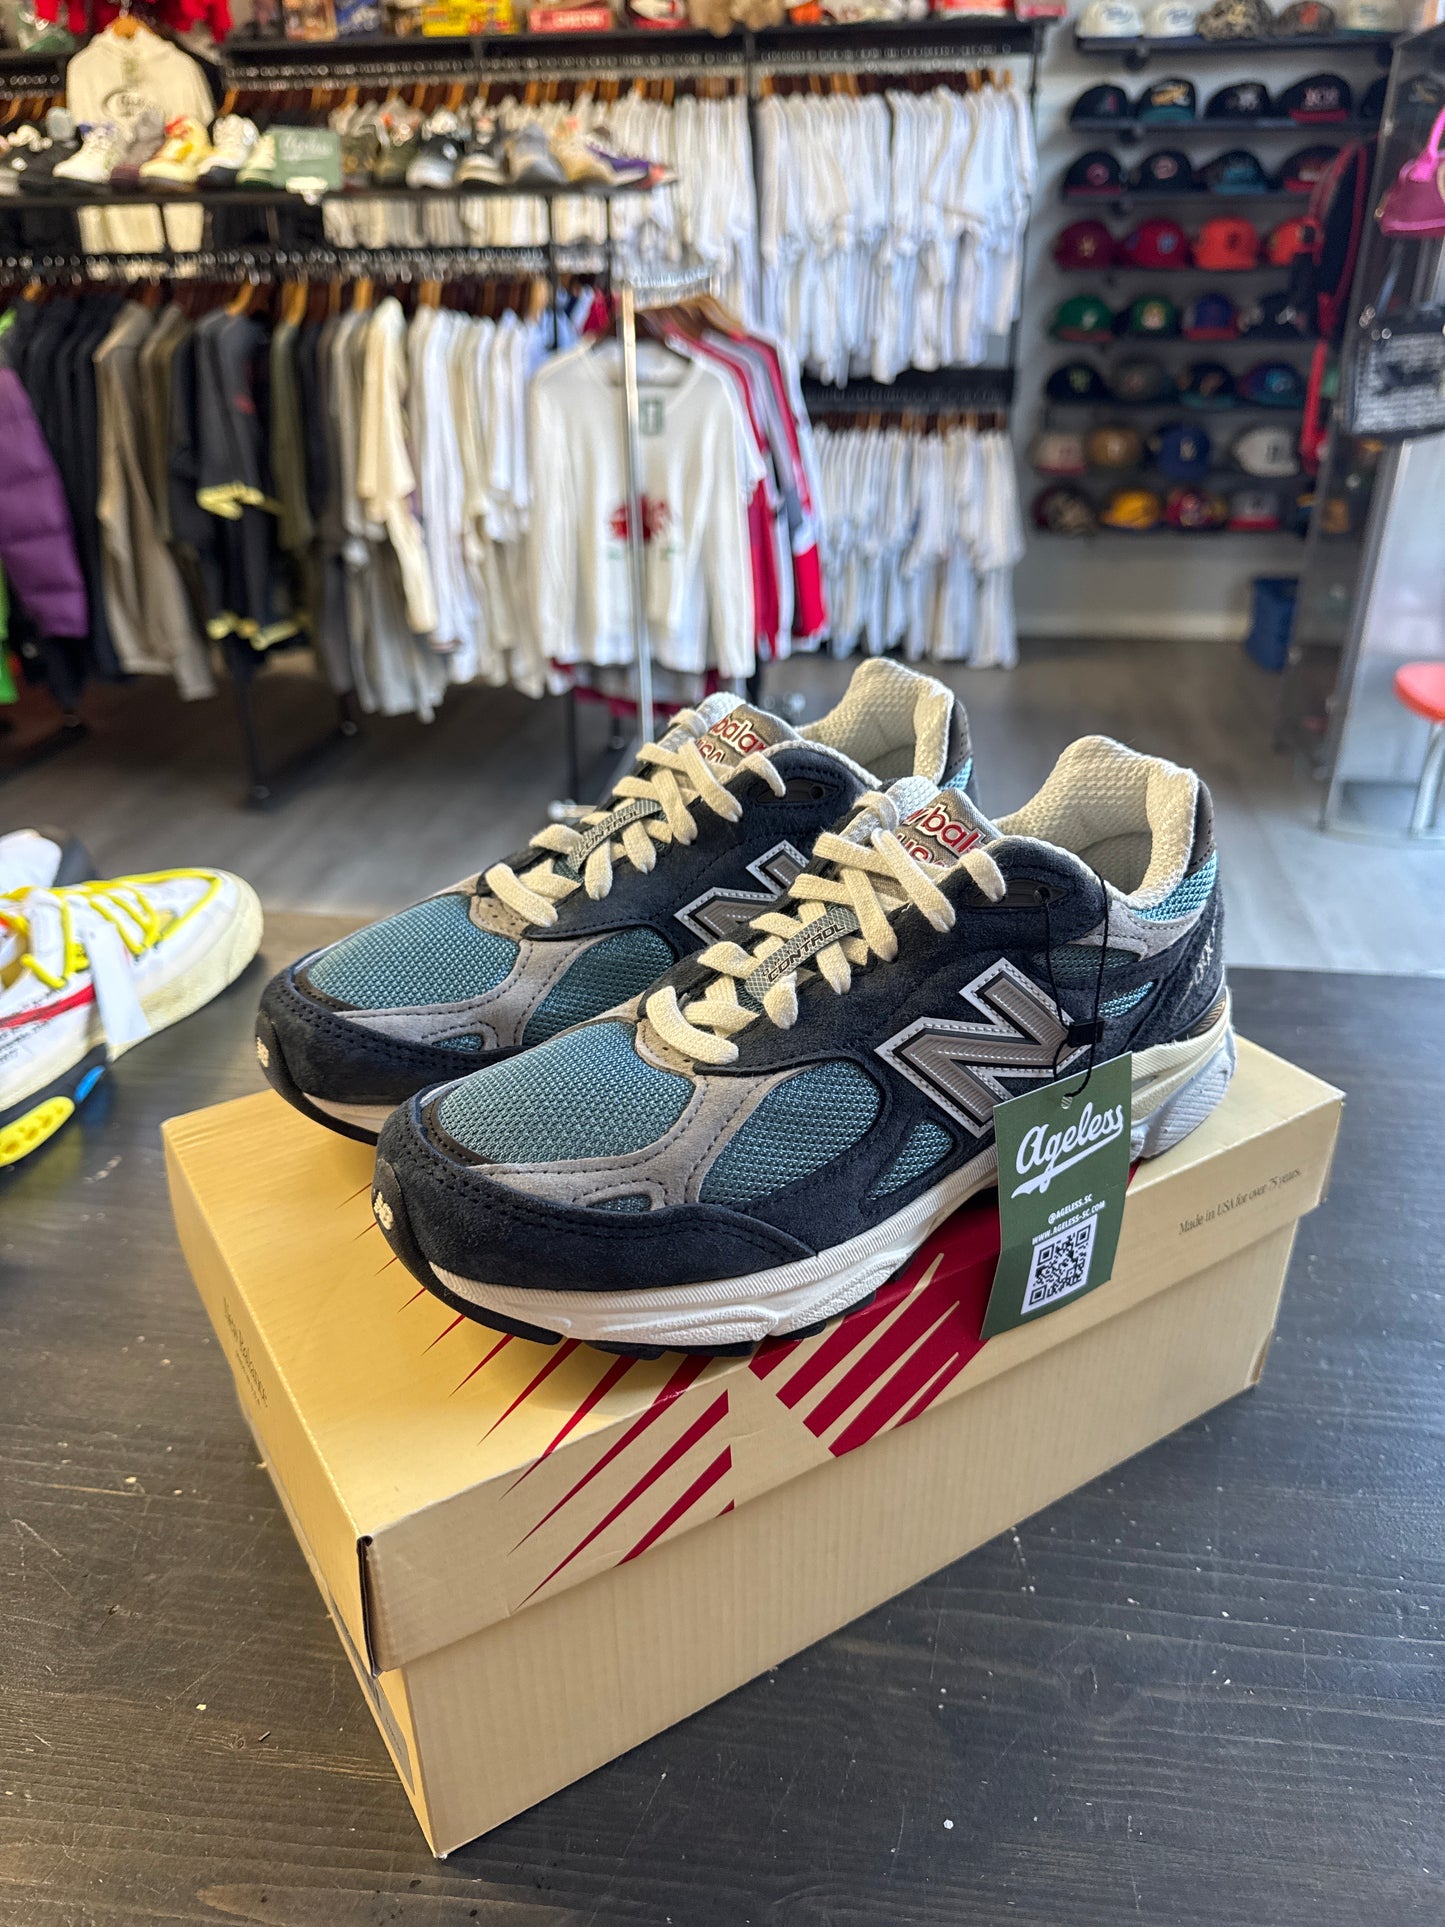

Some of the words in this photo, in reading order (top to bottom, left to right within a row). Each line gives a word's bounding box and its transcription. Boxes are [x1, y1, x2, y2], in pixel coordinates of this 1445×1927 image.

[767, 923, 846, 983] CONTROL
[873, 957, 1093, 1139] N
[1011, 1101, 1124, 1199] Ageless
[1178, 1213, 1204, 1236] Made
[1204, 1208, 1216, 1223] in
